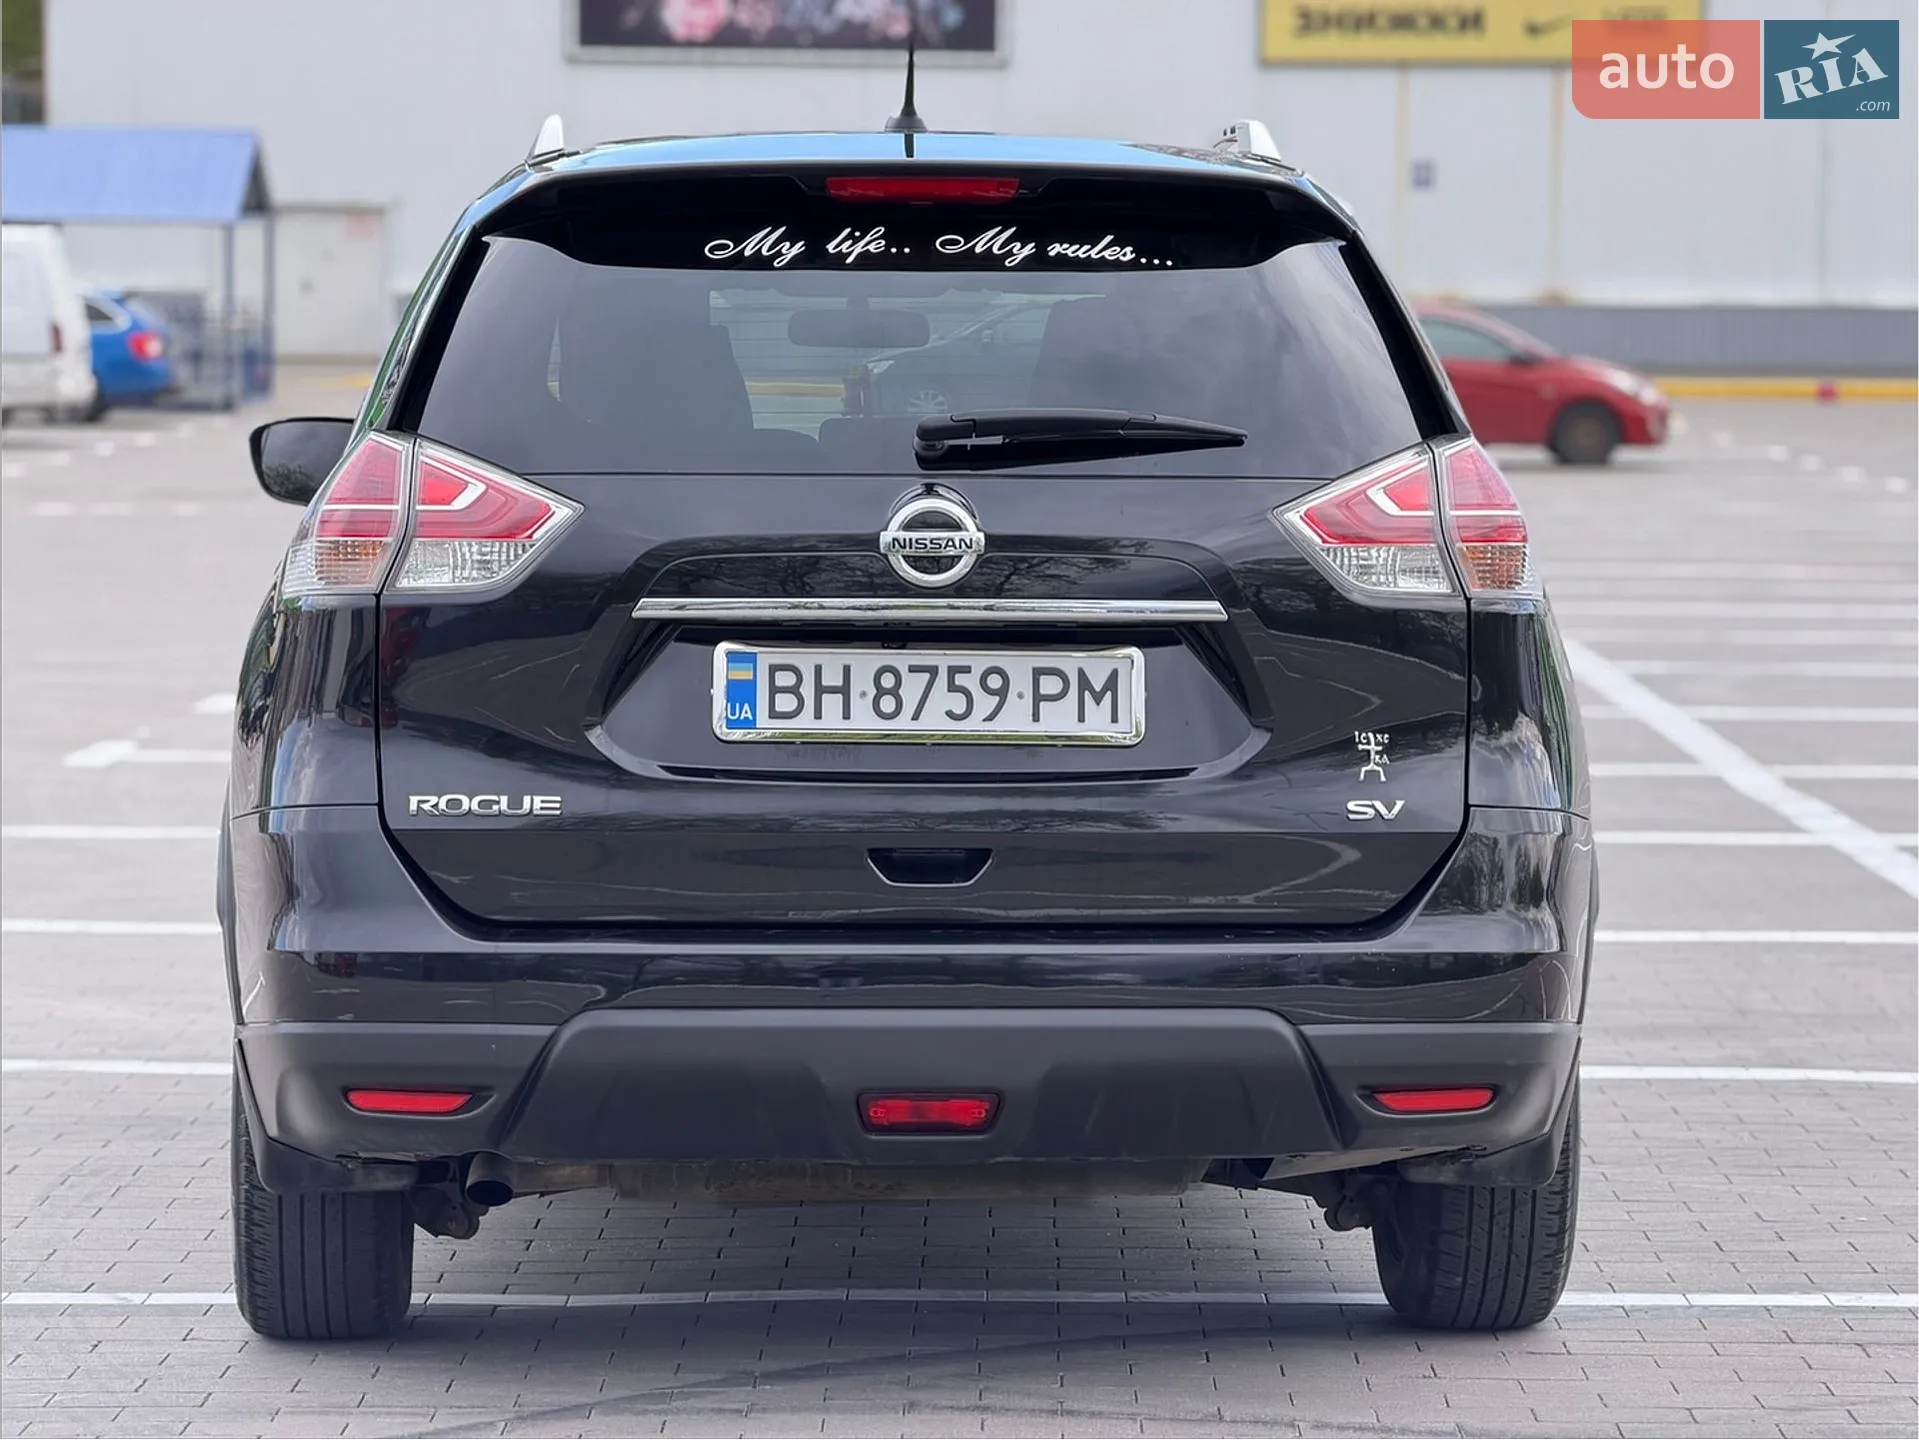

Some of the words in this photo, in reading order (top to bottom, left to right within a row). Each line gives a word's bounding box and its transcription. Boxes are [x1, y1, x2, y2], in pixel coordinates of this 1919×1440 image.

[704, 225, 805, 267] My
[935, 225, 1036, 267] My
[891, 537, 974, 551] NISSAN
[767, 663, 852, 721] BH
[872, 664, 1011, 723] 8759
[1031, 666, 1120, 725] PM
[727, 701, 753, 721] UA
[408, 793, 563, 817] ROGUE
[1346, 799, 1406, 821] SV
